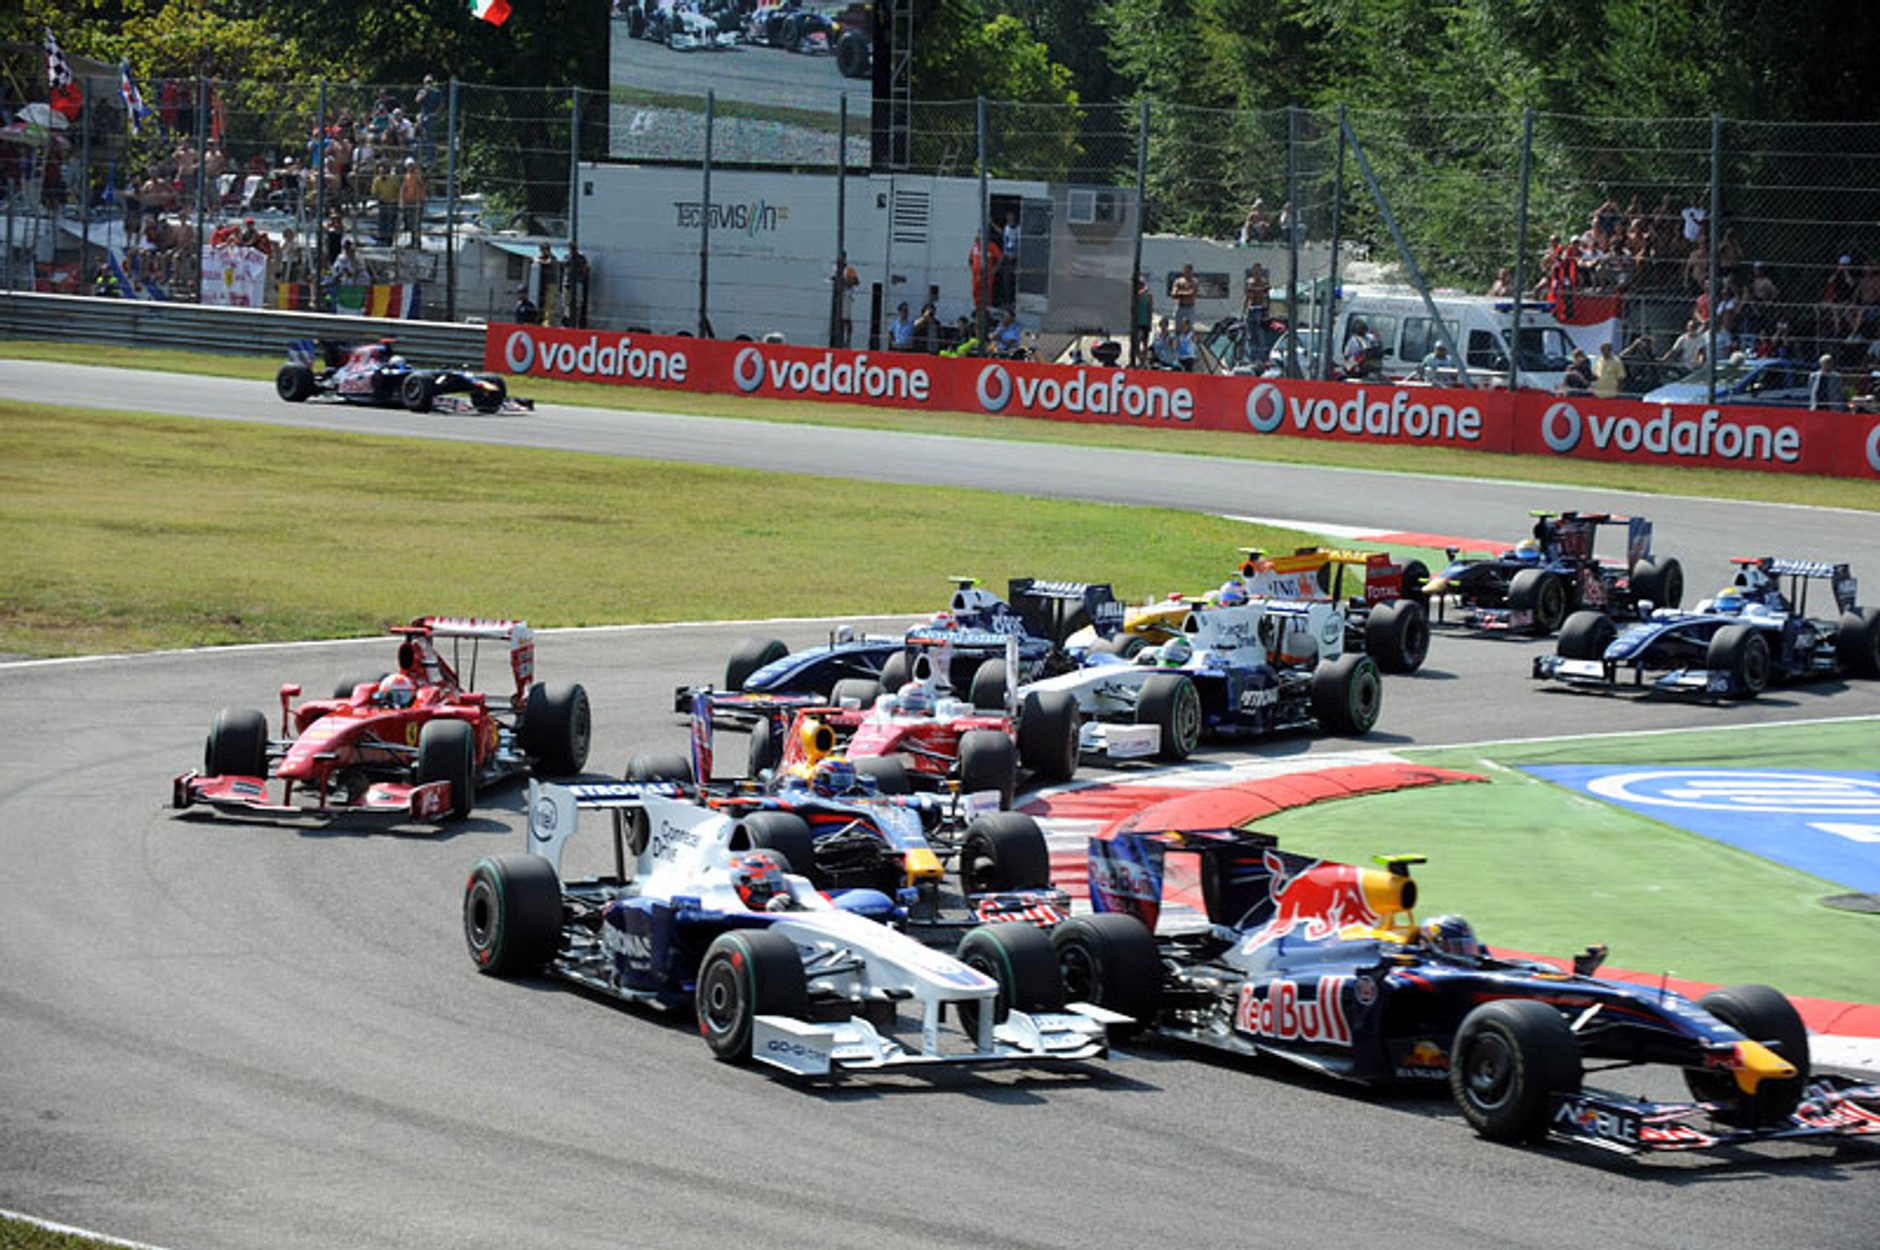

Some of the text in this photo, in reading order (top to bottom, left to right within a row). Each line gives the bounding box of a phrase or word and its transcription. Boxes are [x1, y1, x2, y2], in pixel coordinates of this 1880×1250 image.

[539, 336, 688, 382] vodafone
[770, 353, 930, 400] vodafone
[1016, 370, 1194, 421] vodafone
[1290, 390, 1482, 440] vodafone
[1588, 409, 1801, 462] vodafone
